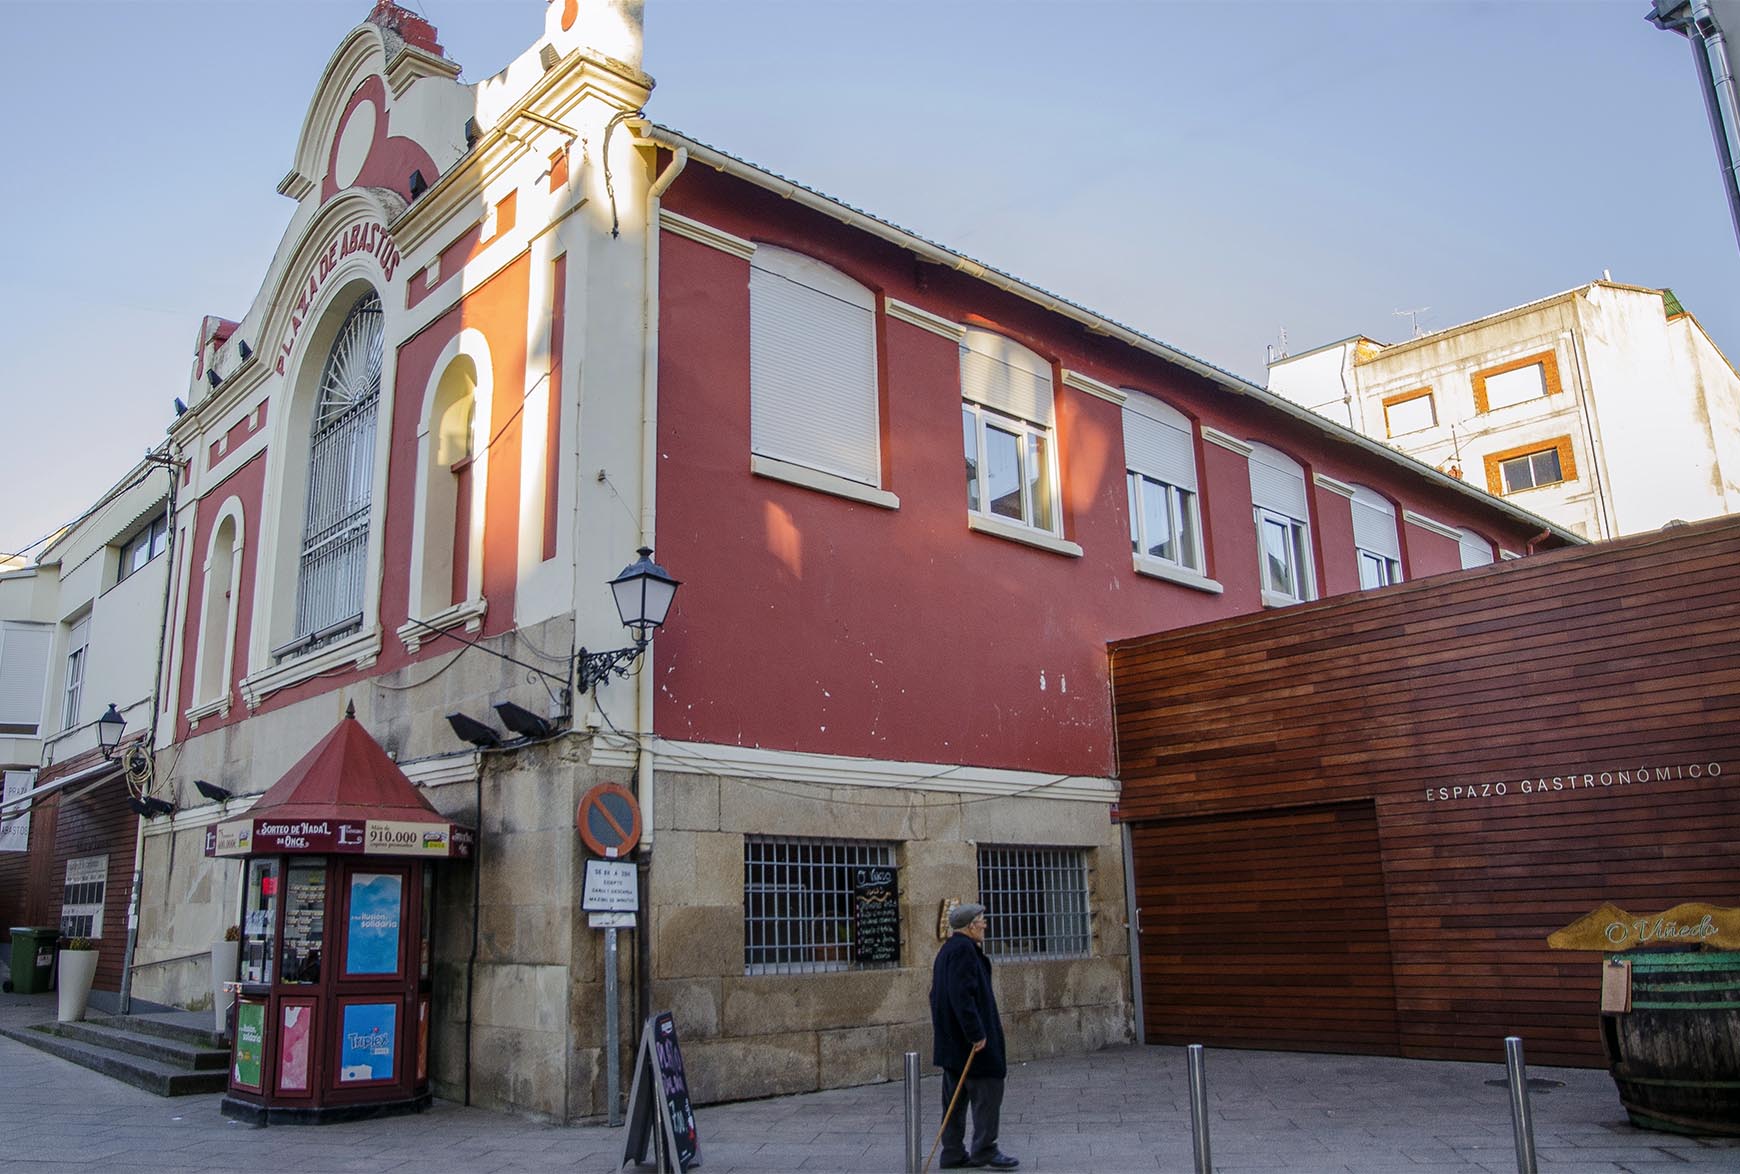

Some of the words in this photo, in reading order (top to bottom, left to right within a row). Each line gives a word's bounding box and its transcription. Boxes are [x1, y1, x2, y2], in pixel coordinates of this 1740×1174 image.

[275, 275, 318, 377] PLAZA
[319, 240, 338, 285] DE
[339, 222, 400, 282] ABASTOS
[1426, 781, 1507, 801] ESPAZO
[1521, 761, 1721, 793] GASTRONÓMICO
[261, 822, 289, 835] SORTEO
[291, 825, 299, 834] DE
[284, 836, 305, 848] ONCE
[370, 831, 417, 844] 910.000
[1605, 922, 1628, 944] O
